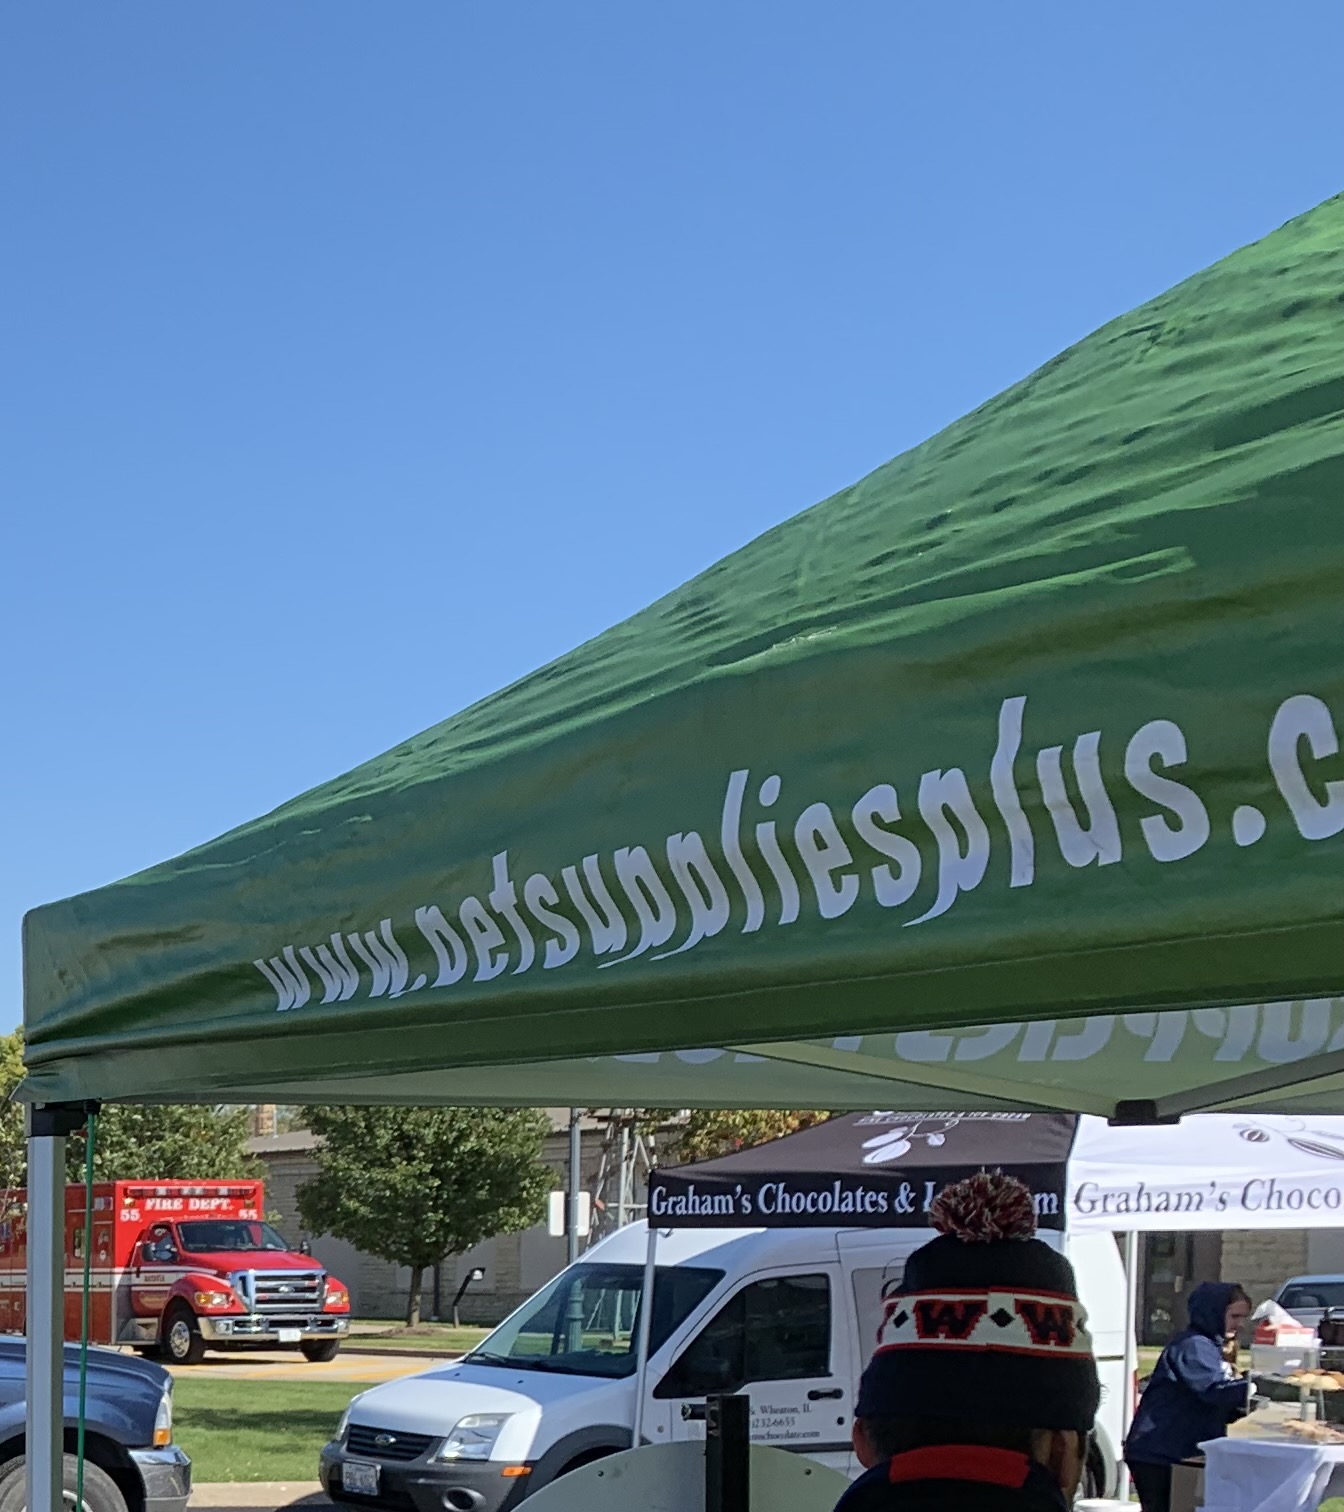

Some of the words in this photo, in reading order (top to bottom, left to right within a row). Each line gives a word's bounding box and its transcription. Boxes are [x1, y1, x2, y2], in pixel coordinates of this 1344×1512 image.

[144, 1198, 183, 1211] FIRE
[652, 1184, 752, 1216] Graham's
[758, 1180, 889, 1214] Chocolates
[894, 1181, 915, 1212] &
[1074, 1180, 1230, 1214] Graham's
[120, 1208, 141, 1222] 55
